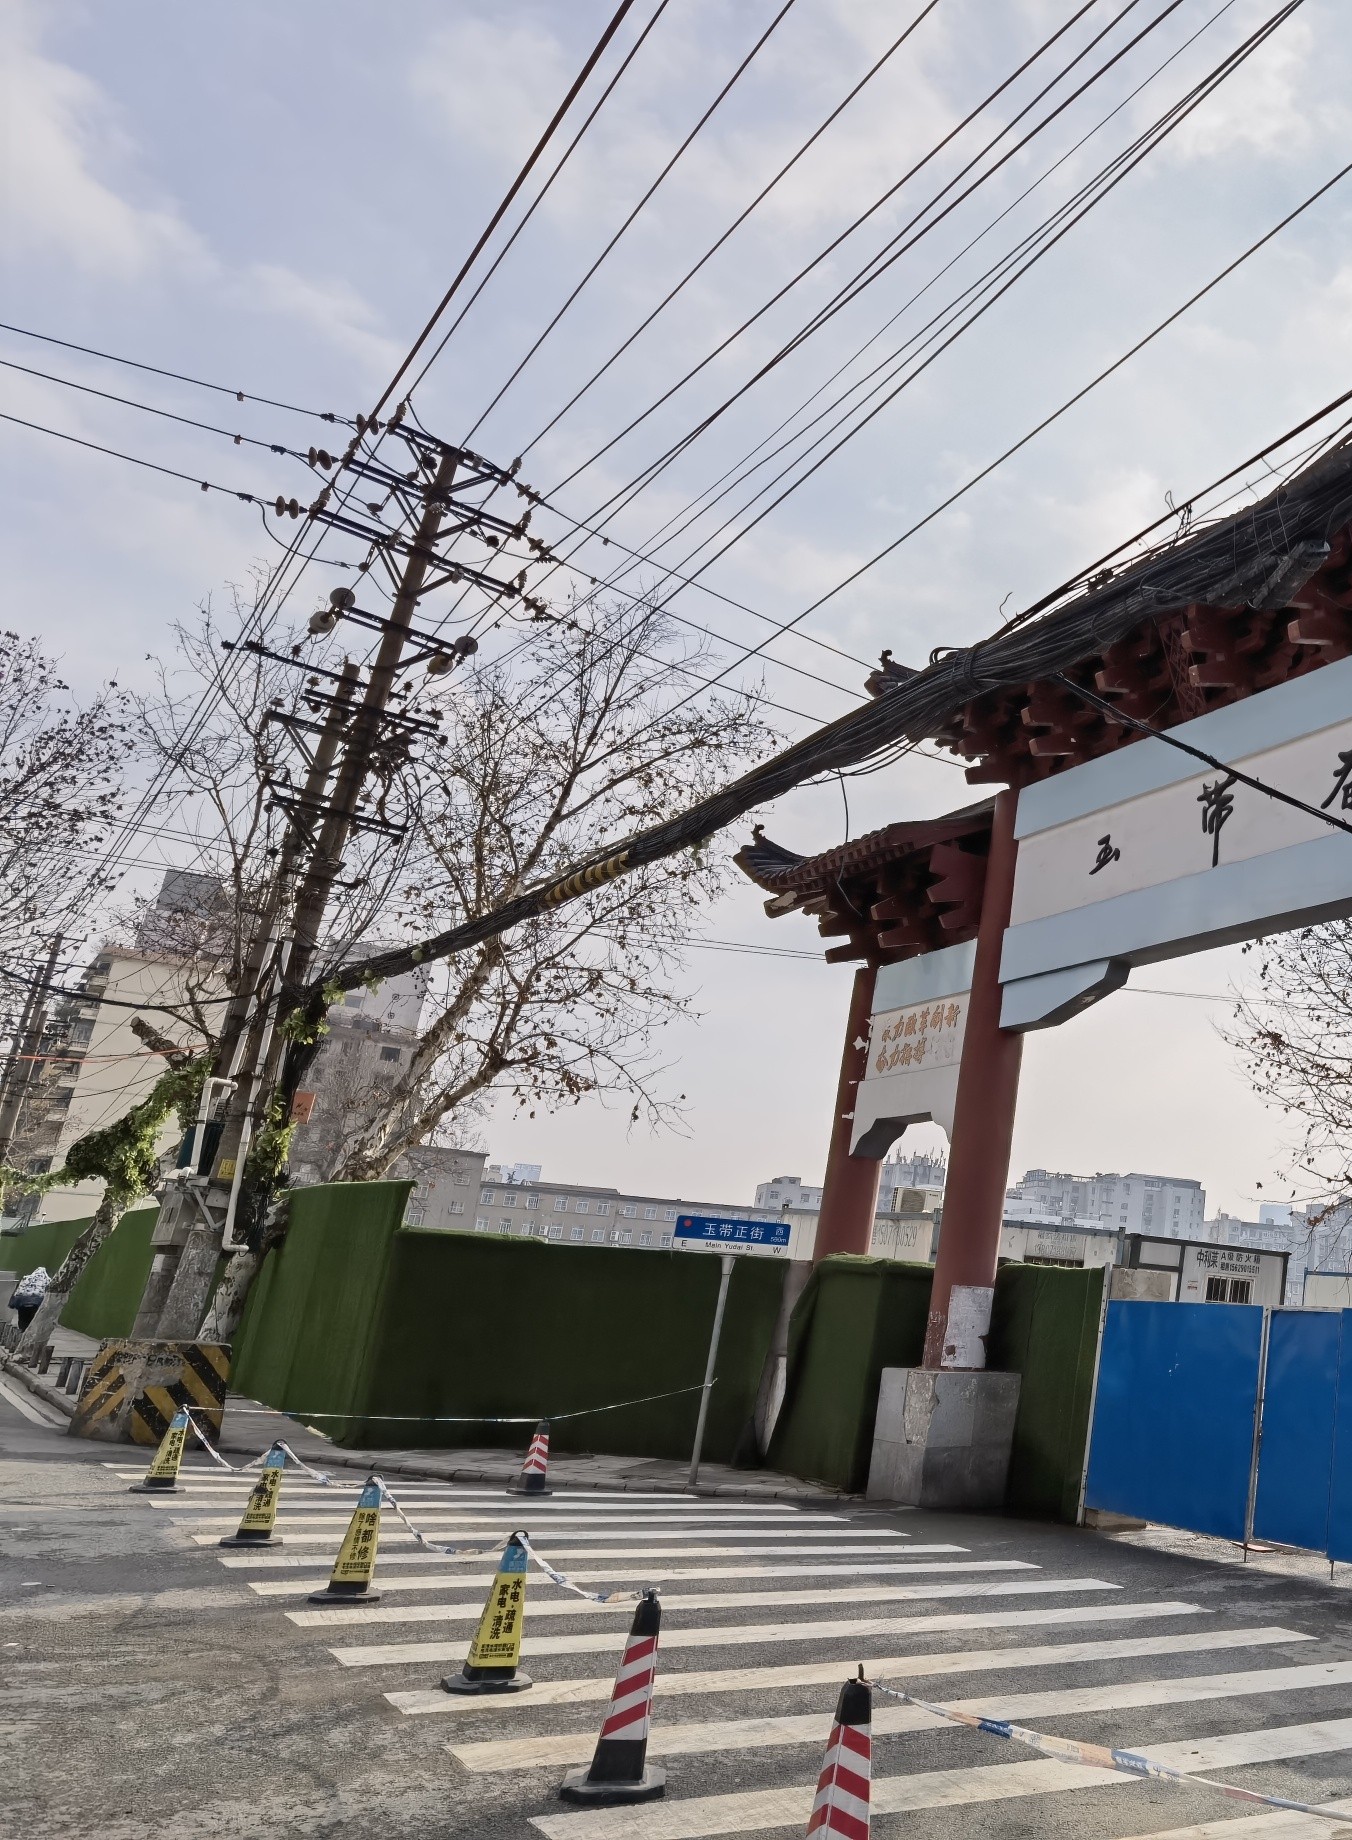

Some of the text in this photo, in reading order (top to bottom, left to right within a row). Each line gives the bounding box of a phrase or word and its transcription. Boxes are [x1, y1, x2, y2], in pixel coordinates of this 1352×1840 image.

[702, 1222, 765, 1240] 玉带正街
[775, 1226, 785, 1236] 西
[681, 1239, 688, 1248] E
[705, 1241, 722, 1249] Main
[772, 1246, 782, 1254] W
[358, 1512, 377, 1560] 啥都修
